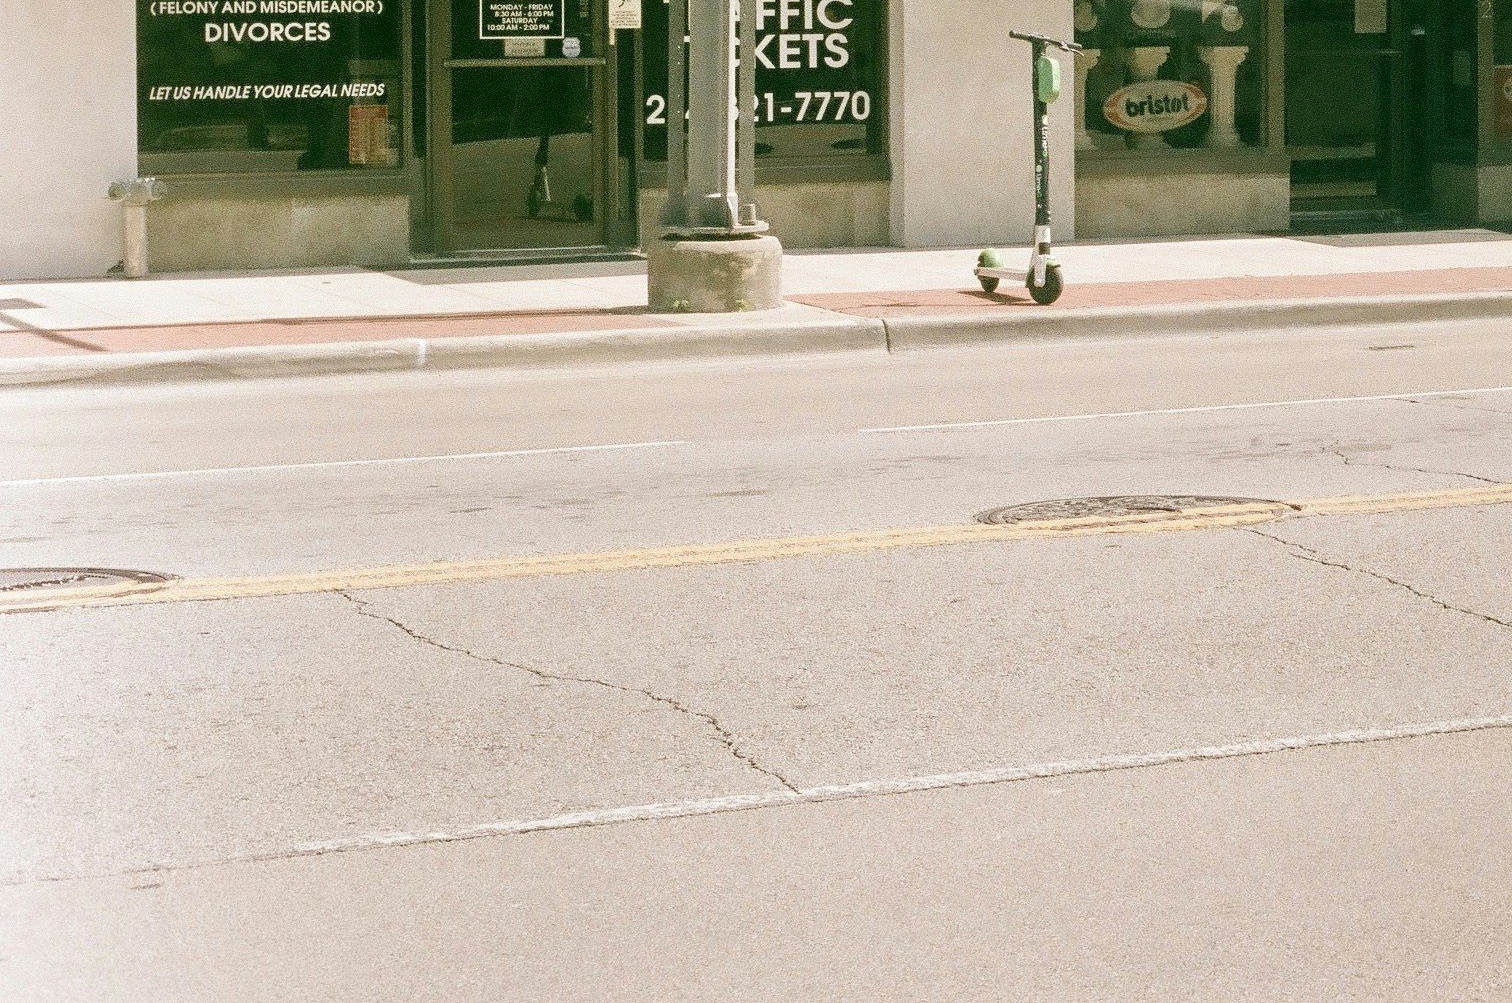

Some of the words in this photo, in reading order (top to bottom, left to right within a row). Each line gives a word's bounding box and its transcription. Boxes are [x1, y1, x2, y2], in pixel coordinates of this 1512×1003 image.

[222, 1, 257, 14] AND
[204, 22, 331, 43] DIVORCES
[149, 87, 173, 101] LET
[173, 86, 191, 100] US
[193, 85, 251, 100] HANDLE
[253, 85, 295, 99] YOUR
[294, 84, 338, 98] LEGAL
[340, 83, 385, 97] NEEDS
